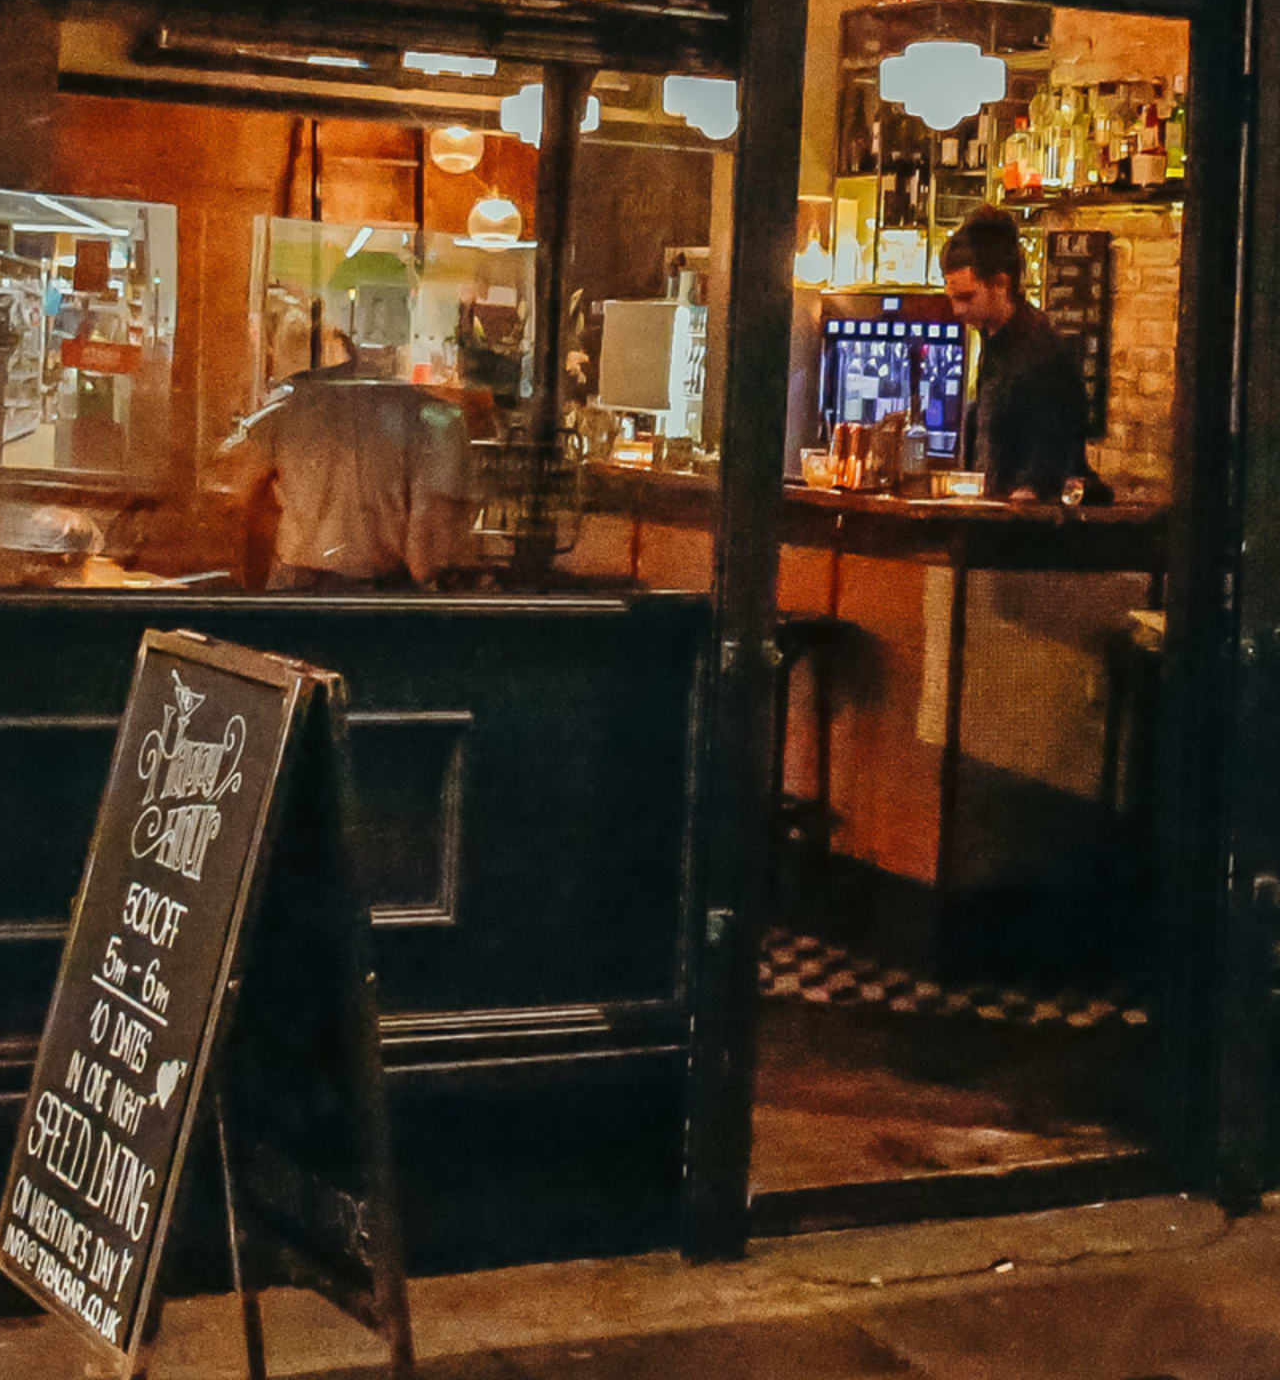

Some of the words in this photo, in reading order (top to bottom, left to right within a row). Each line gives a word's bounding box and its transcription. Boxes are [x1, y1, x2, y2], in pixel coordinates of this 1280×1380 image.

[90, 999, 110, 1044] 10
[109, 1012, 153, 1074] DATES
[65, 1049, 86, 1094] IN
[83, 1062, 112, 1112] ONE
[12, 1175, 33, 1219] ON
[28, 1091, 92, 1190] SPEED
[86, 1131, 156, 1242] DATING
